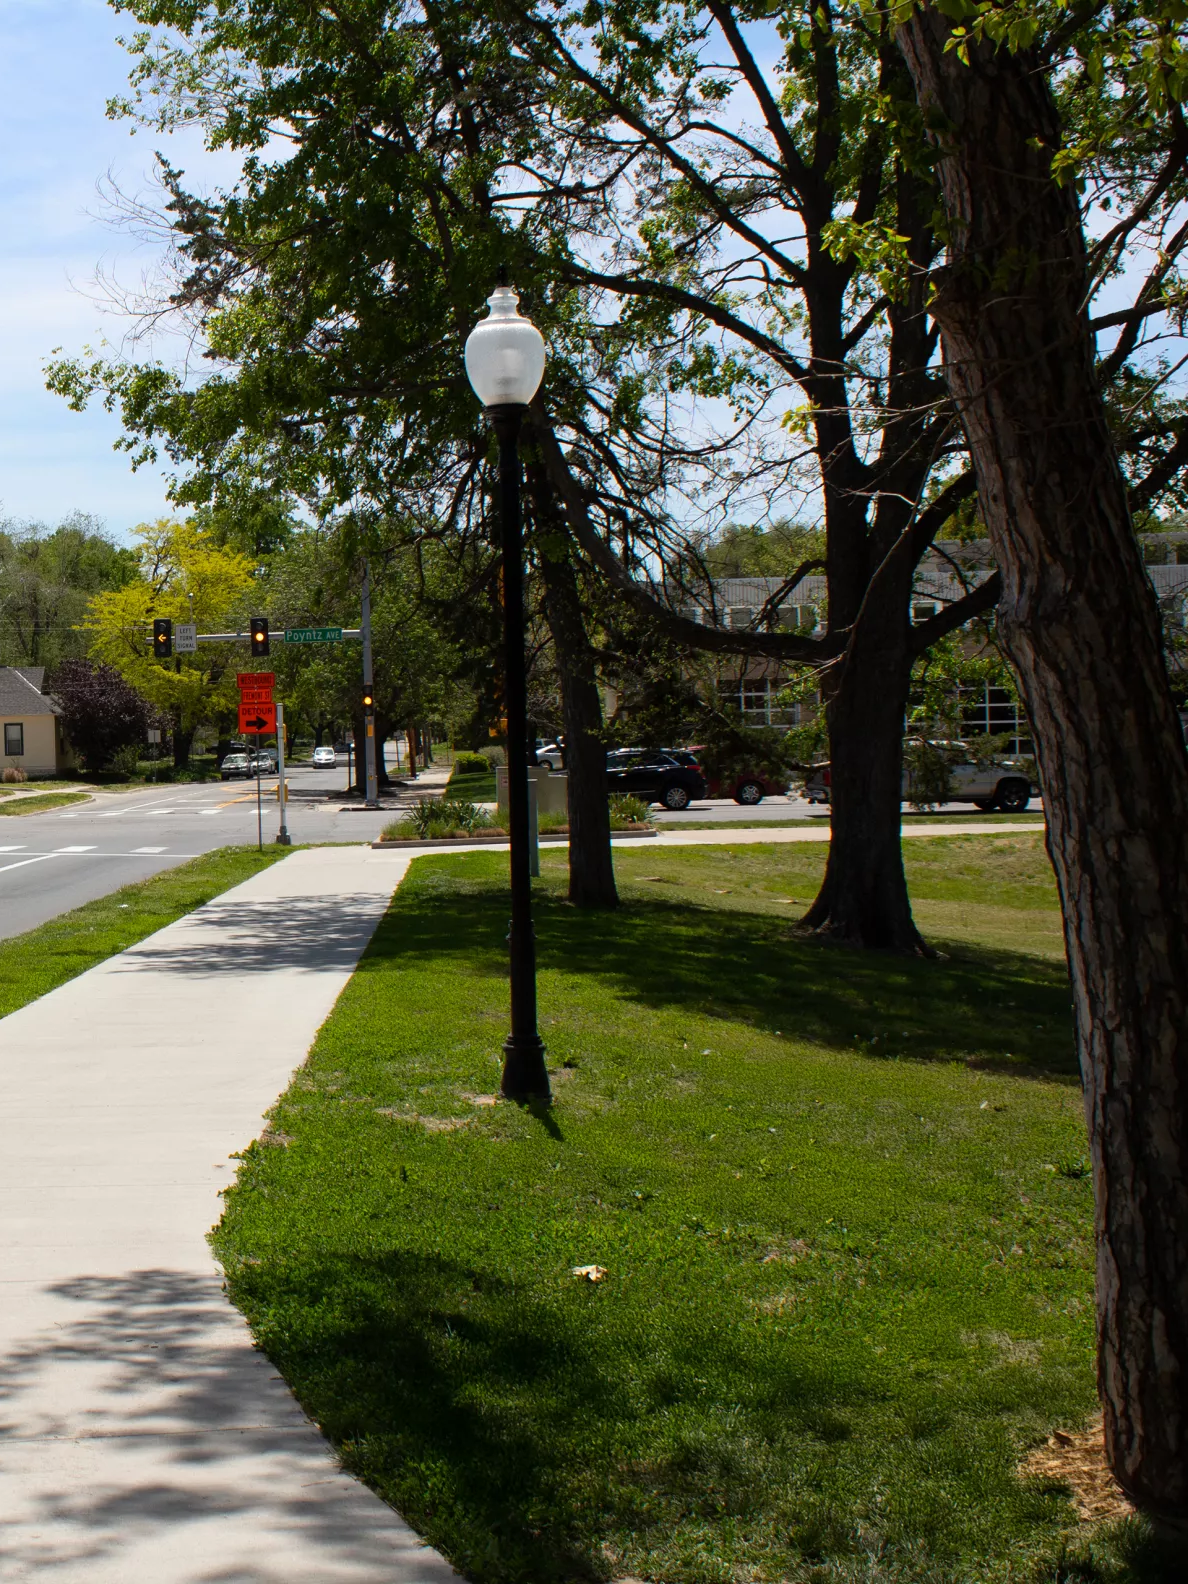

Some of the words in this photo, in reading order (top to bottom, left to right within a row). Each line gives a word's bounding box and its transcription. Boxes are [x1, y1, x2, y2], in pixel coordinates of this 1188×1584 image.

[286, 630, 323, 642] Poyntz
[326, 630, 340, 639] AVE
[240, 675, 272, 685] WESTBOUND
[243, 691, 263, 701] FREMONT
[264, 691, 270, 700] ST
[241, 707, 273, 716] DETOUR
